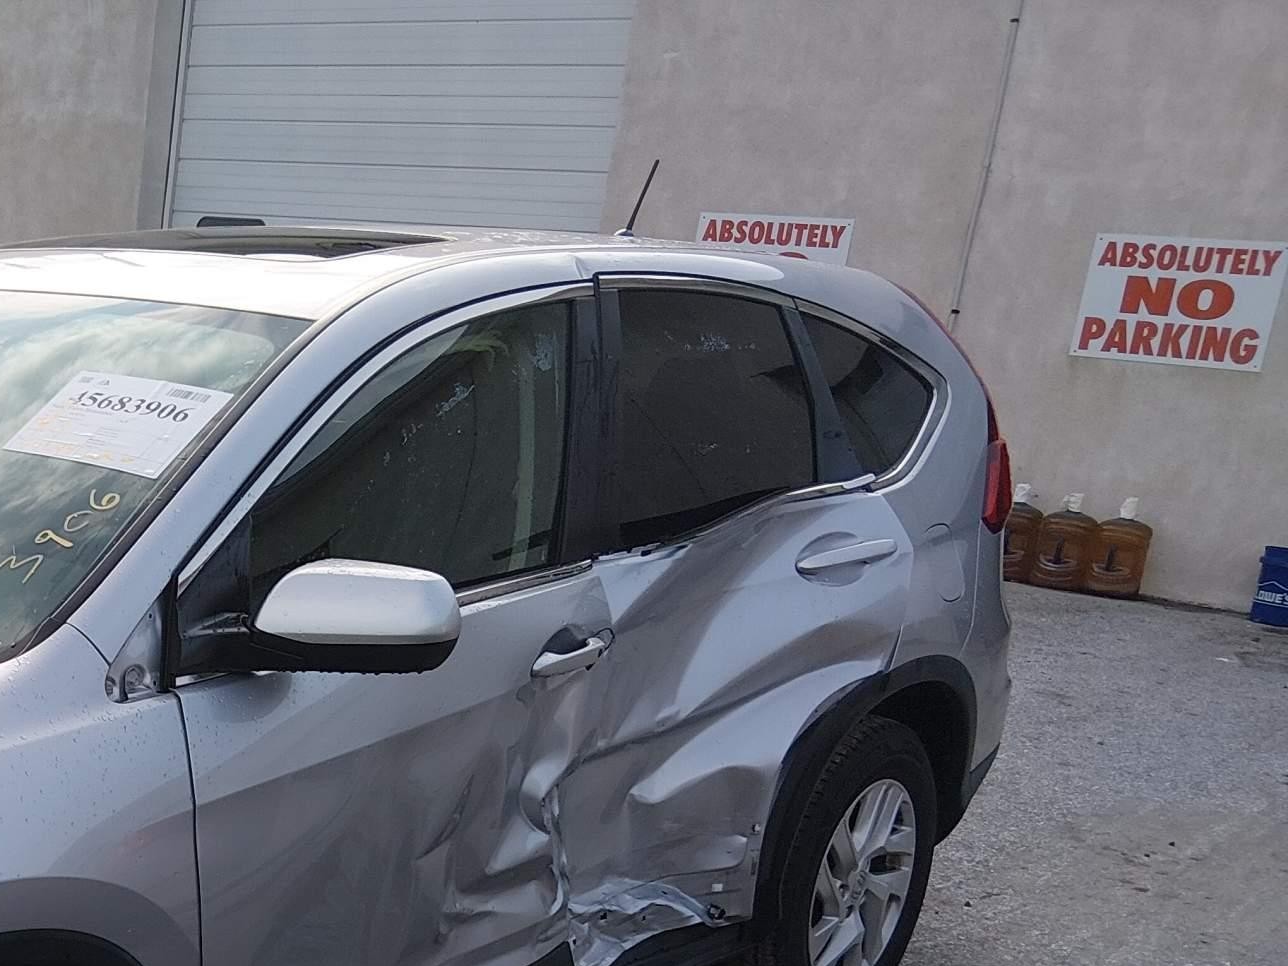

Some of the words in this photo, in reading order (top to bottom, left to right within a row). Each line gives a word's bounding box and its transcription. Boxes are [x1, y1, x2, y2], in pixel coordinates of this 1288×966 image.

[702, 219, 847, 249] ABSOLUTELY
[1097, 241, 1283, 277] ABSOLUTELY
[1119, 275, 1236, 321] NO
[1078, 316, 1261, 365] PARKING
